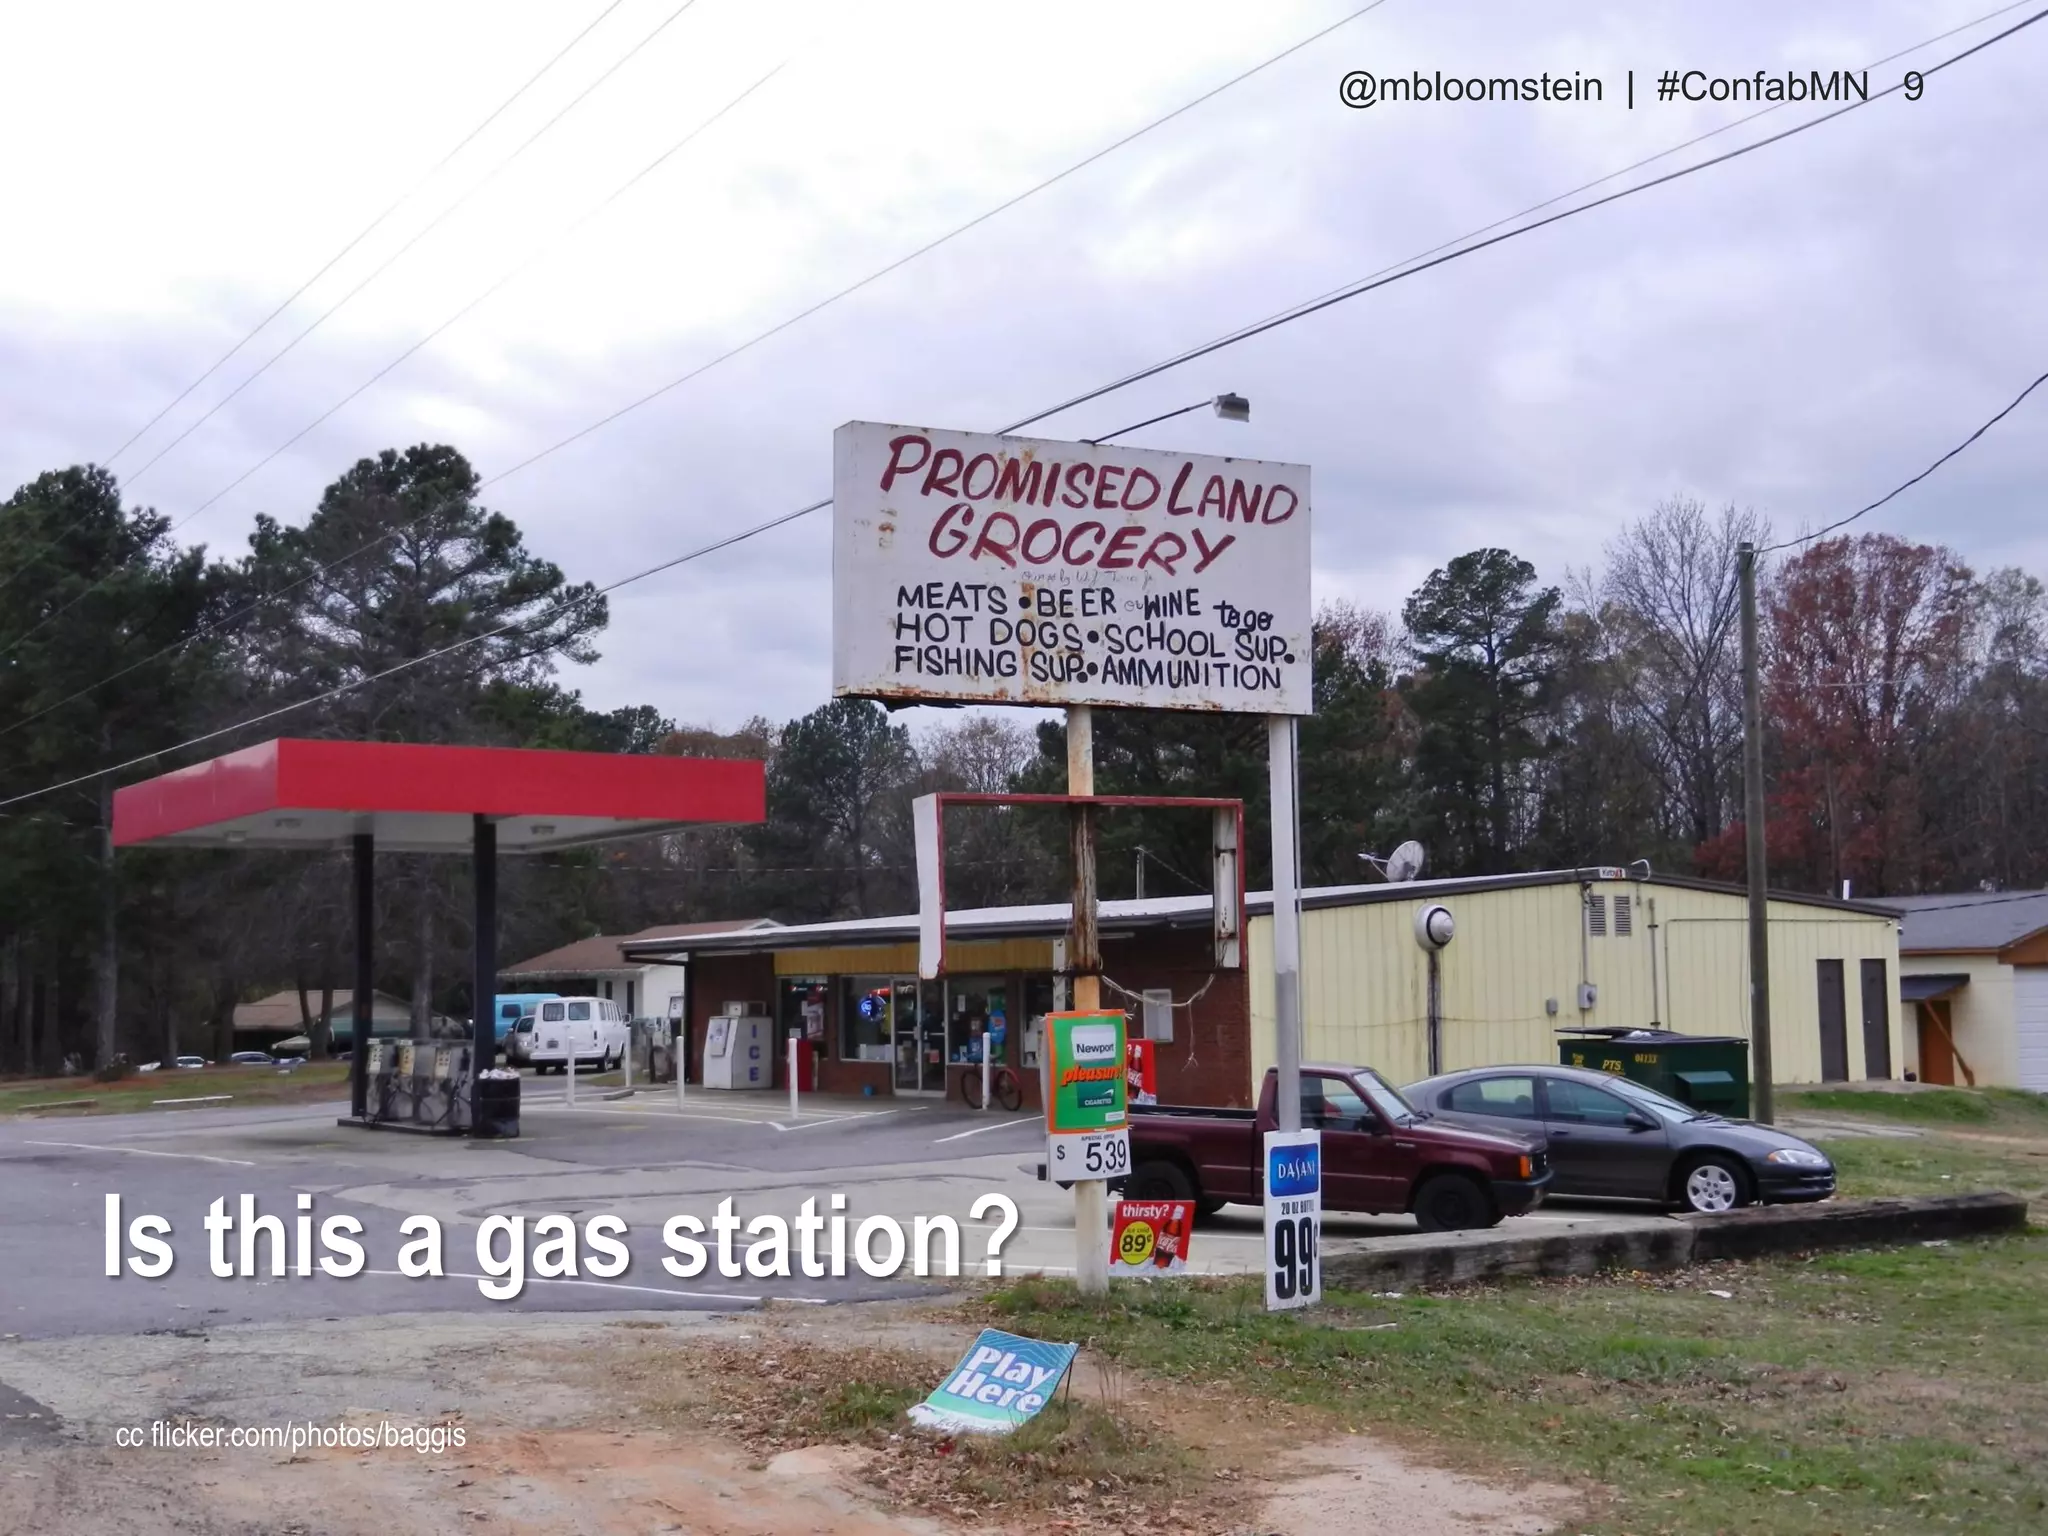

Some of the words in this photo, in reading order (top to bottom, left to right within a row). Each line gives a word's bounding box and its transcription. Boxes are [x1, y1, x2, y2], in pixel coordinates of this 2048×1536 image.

[880, 434, 1161, 511] PROMISED
[1167, 461, 1298, 525] LAND
[928, 502, 1236, 576] GROCERY
[896, 581, 1008, 615] MEATS
[1036, 586, 1118, 618] BEER
[1144, 588, 1201, 621] WINE
[895, 612, 974, 643] HOT
[990, 619, 1083, 651] DOGS
[1104, 620, 1226, 659] SCHOOL
[895, 645, 1018, 678] FISHING
[1101, 659, 1282, 691] AMMUNITION
[748, 1024, 760, 1082] ICE
[1076, 1043, 1115, 1055] Newport
[1056, 1144, 1066, 1161] $
[1278, 1157, 1316, 1182] DASANI
[1122, 1203, 1170, 1219] thirsty?
[1281, 1201, 1291, 1215] 20
[965, 1345, 1056, 1392] Play
[946, 1369, 1043, 1413] Here
